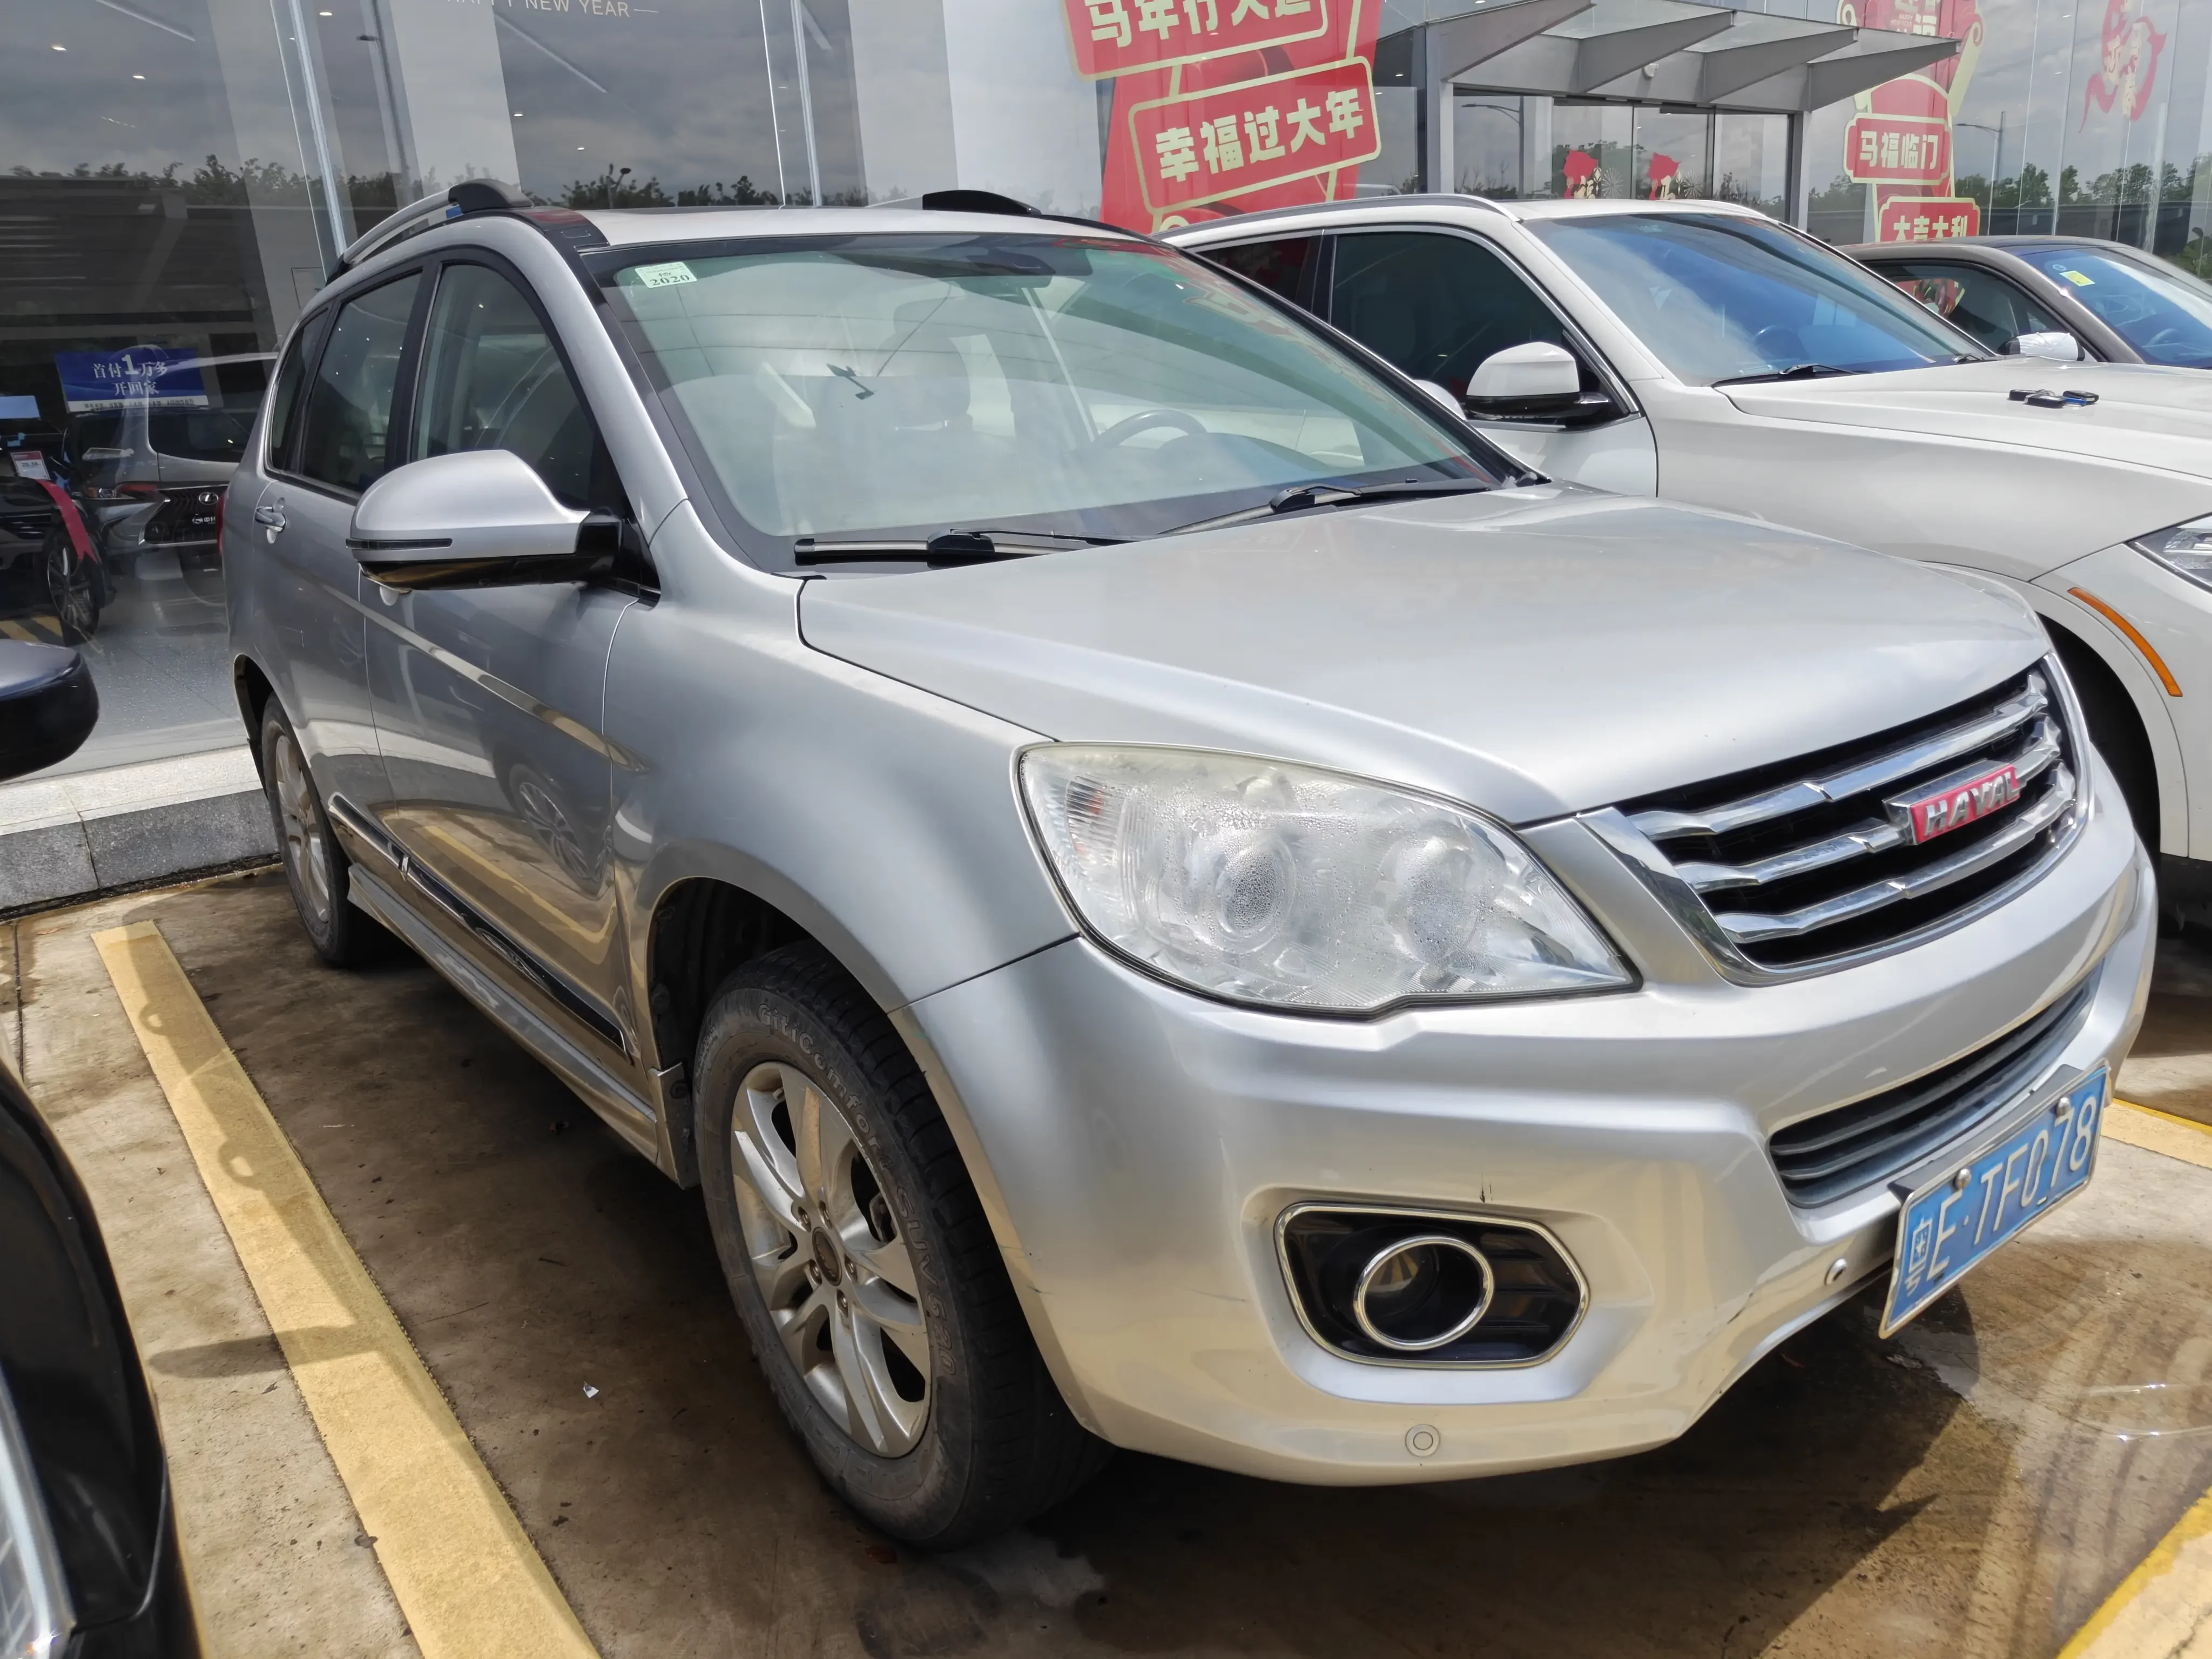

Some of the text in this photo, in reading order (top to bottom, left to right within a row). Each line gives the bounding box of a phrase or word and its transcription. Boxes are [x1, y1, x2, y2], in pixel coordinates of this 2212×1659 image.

[525, 0, 569, 12] NEW
[579, 0, 630, 17] YEAR
[1156, 89, 1363, 183] 幸福过大年
[1860, 131, 1938, 170] 马福临门
[1893, 215, 1968, 242] 大吉大利
[650, 275, 690, 286] 2020
[92, 354, 168, 379] 首付1万多
[114, 381, 160, 396] 开回家
[1924, 772, 2020, 836] HAVAL
[896, 1186, 939, 1289] SUV
